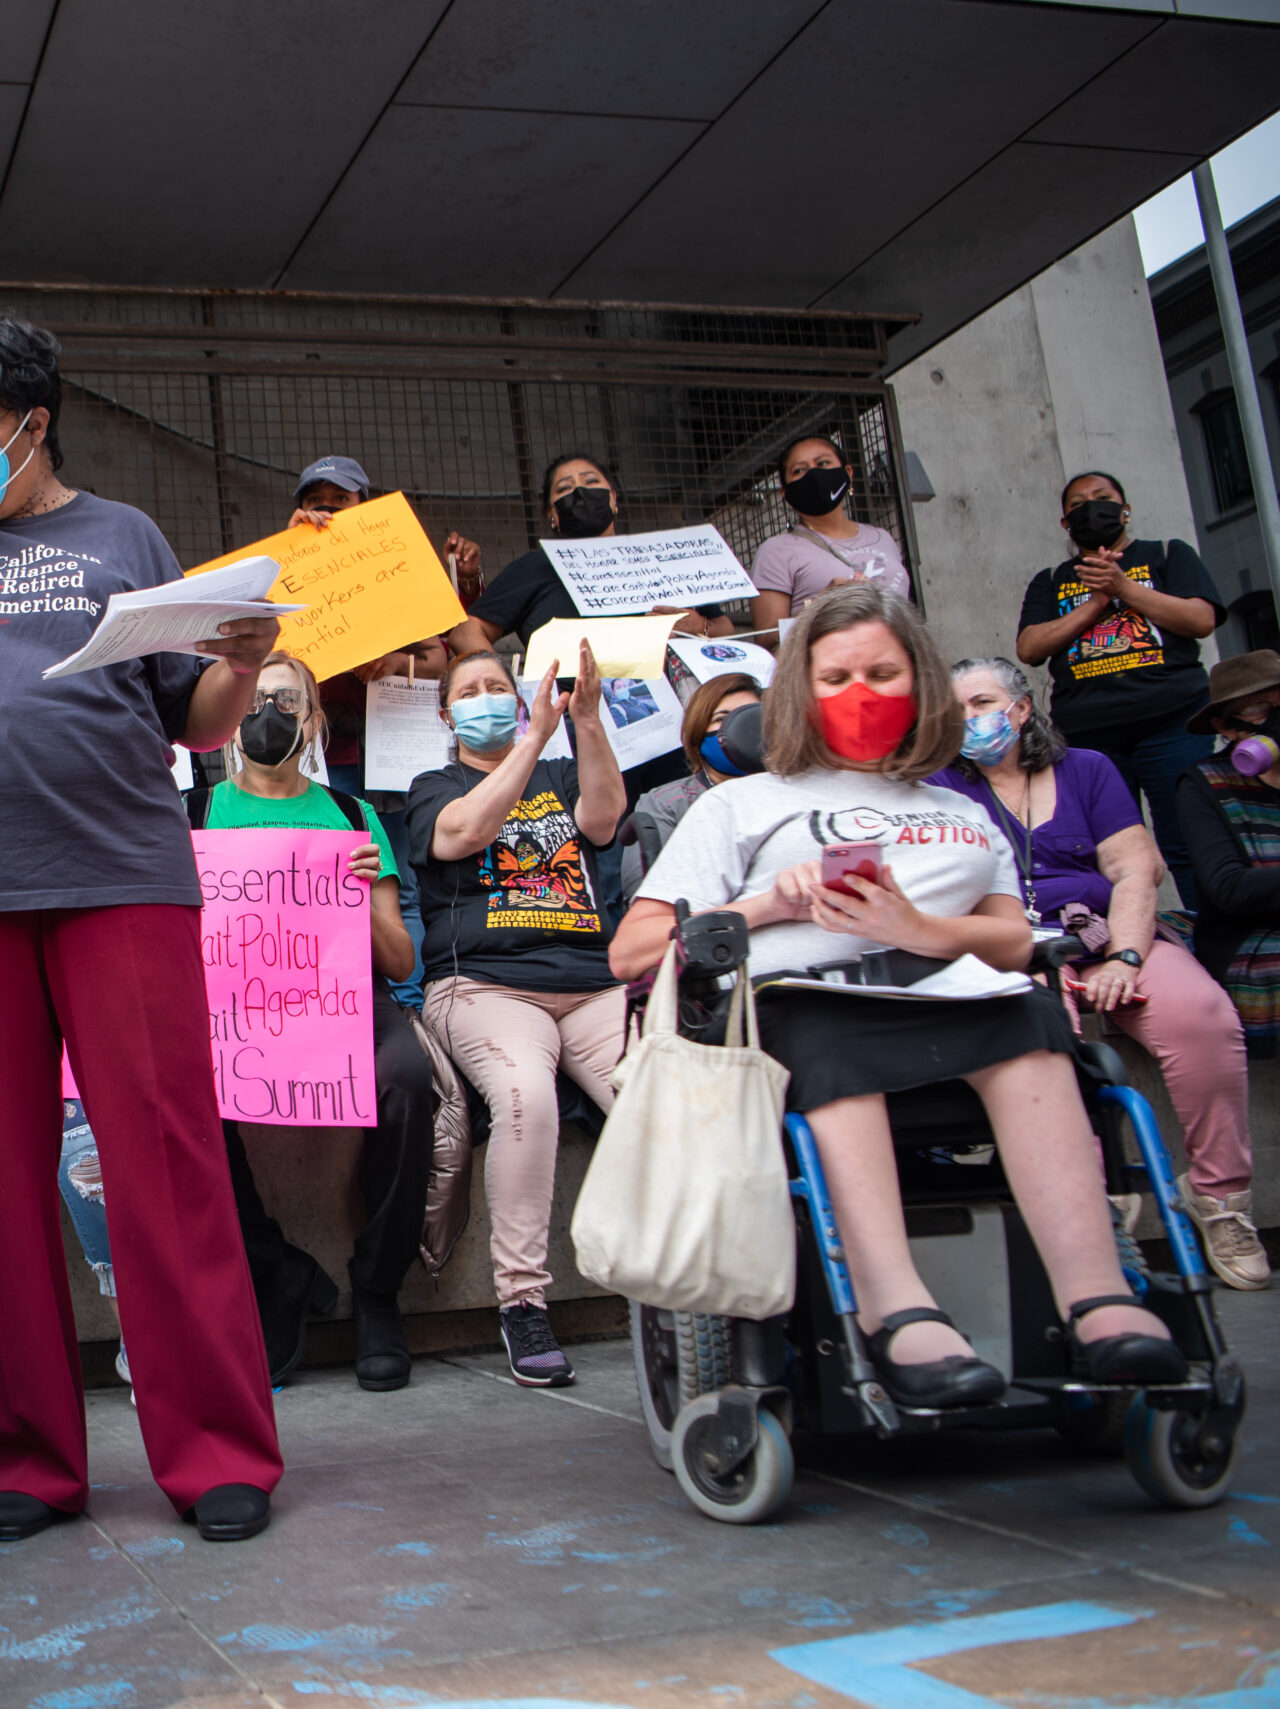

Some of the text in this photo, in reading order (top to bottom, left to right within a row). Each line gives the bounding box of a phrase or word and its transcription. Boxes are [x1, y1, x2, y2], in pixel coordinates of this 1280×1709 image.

[330, 532, 349, 547] del
[357, 516, 393, 538] Hogar
[280, 536, 408, 594] ESENCIALES
[376, 560, 410, 584] are
[1, 571, 84, 594] Retired
[883, 811, 949, 821] SENIOR
[896, 826, 991, 852] ACTION
[196, 850, 365, 908] ssentials
[245, 976, 360, 1037] Agenda
[232, 1046, 371, 1121] Summit
